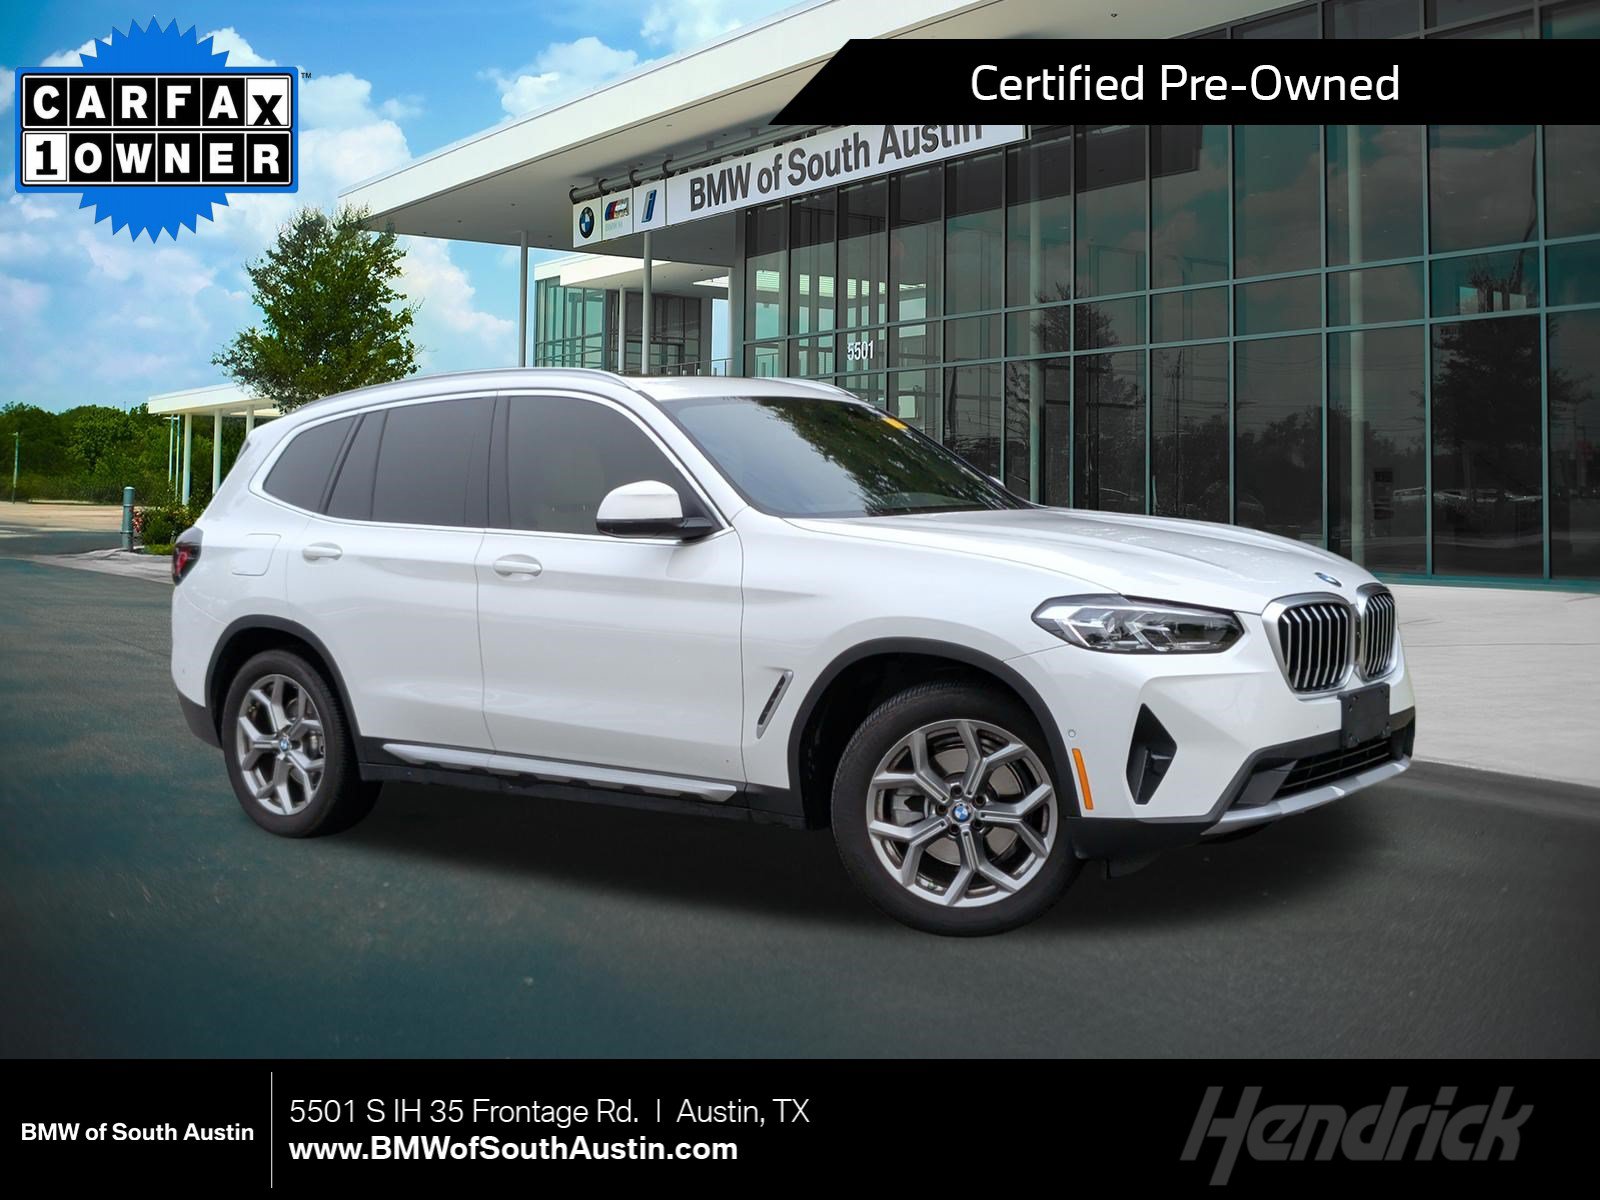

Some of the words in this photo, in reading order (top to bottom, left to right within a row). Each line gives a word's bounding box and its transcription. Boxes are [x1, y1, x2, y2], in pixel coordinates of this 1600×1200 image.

[690, 162, 751, 212] BMW
[757, 153, 783, 194] of
[787, 132, 870, 186] South
[847, 340, 874, 361] 5501
